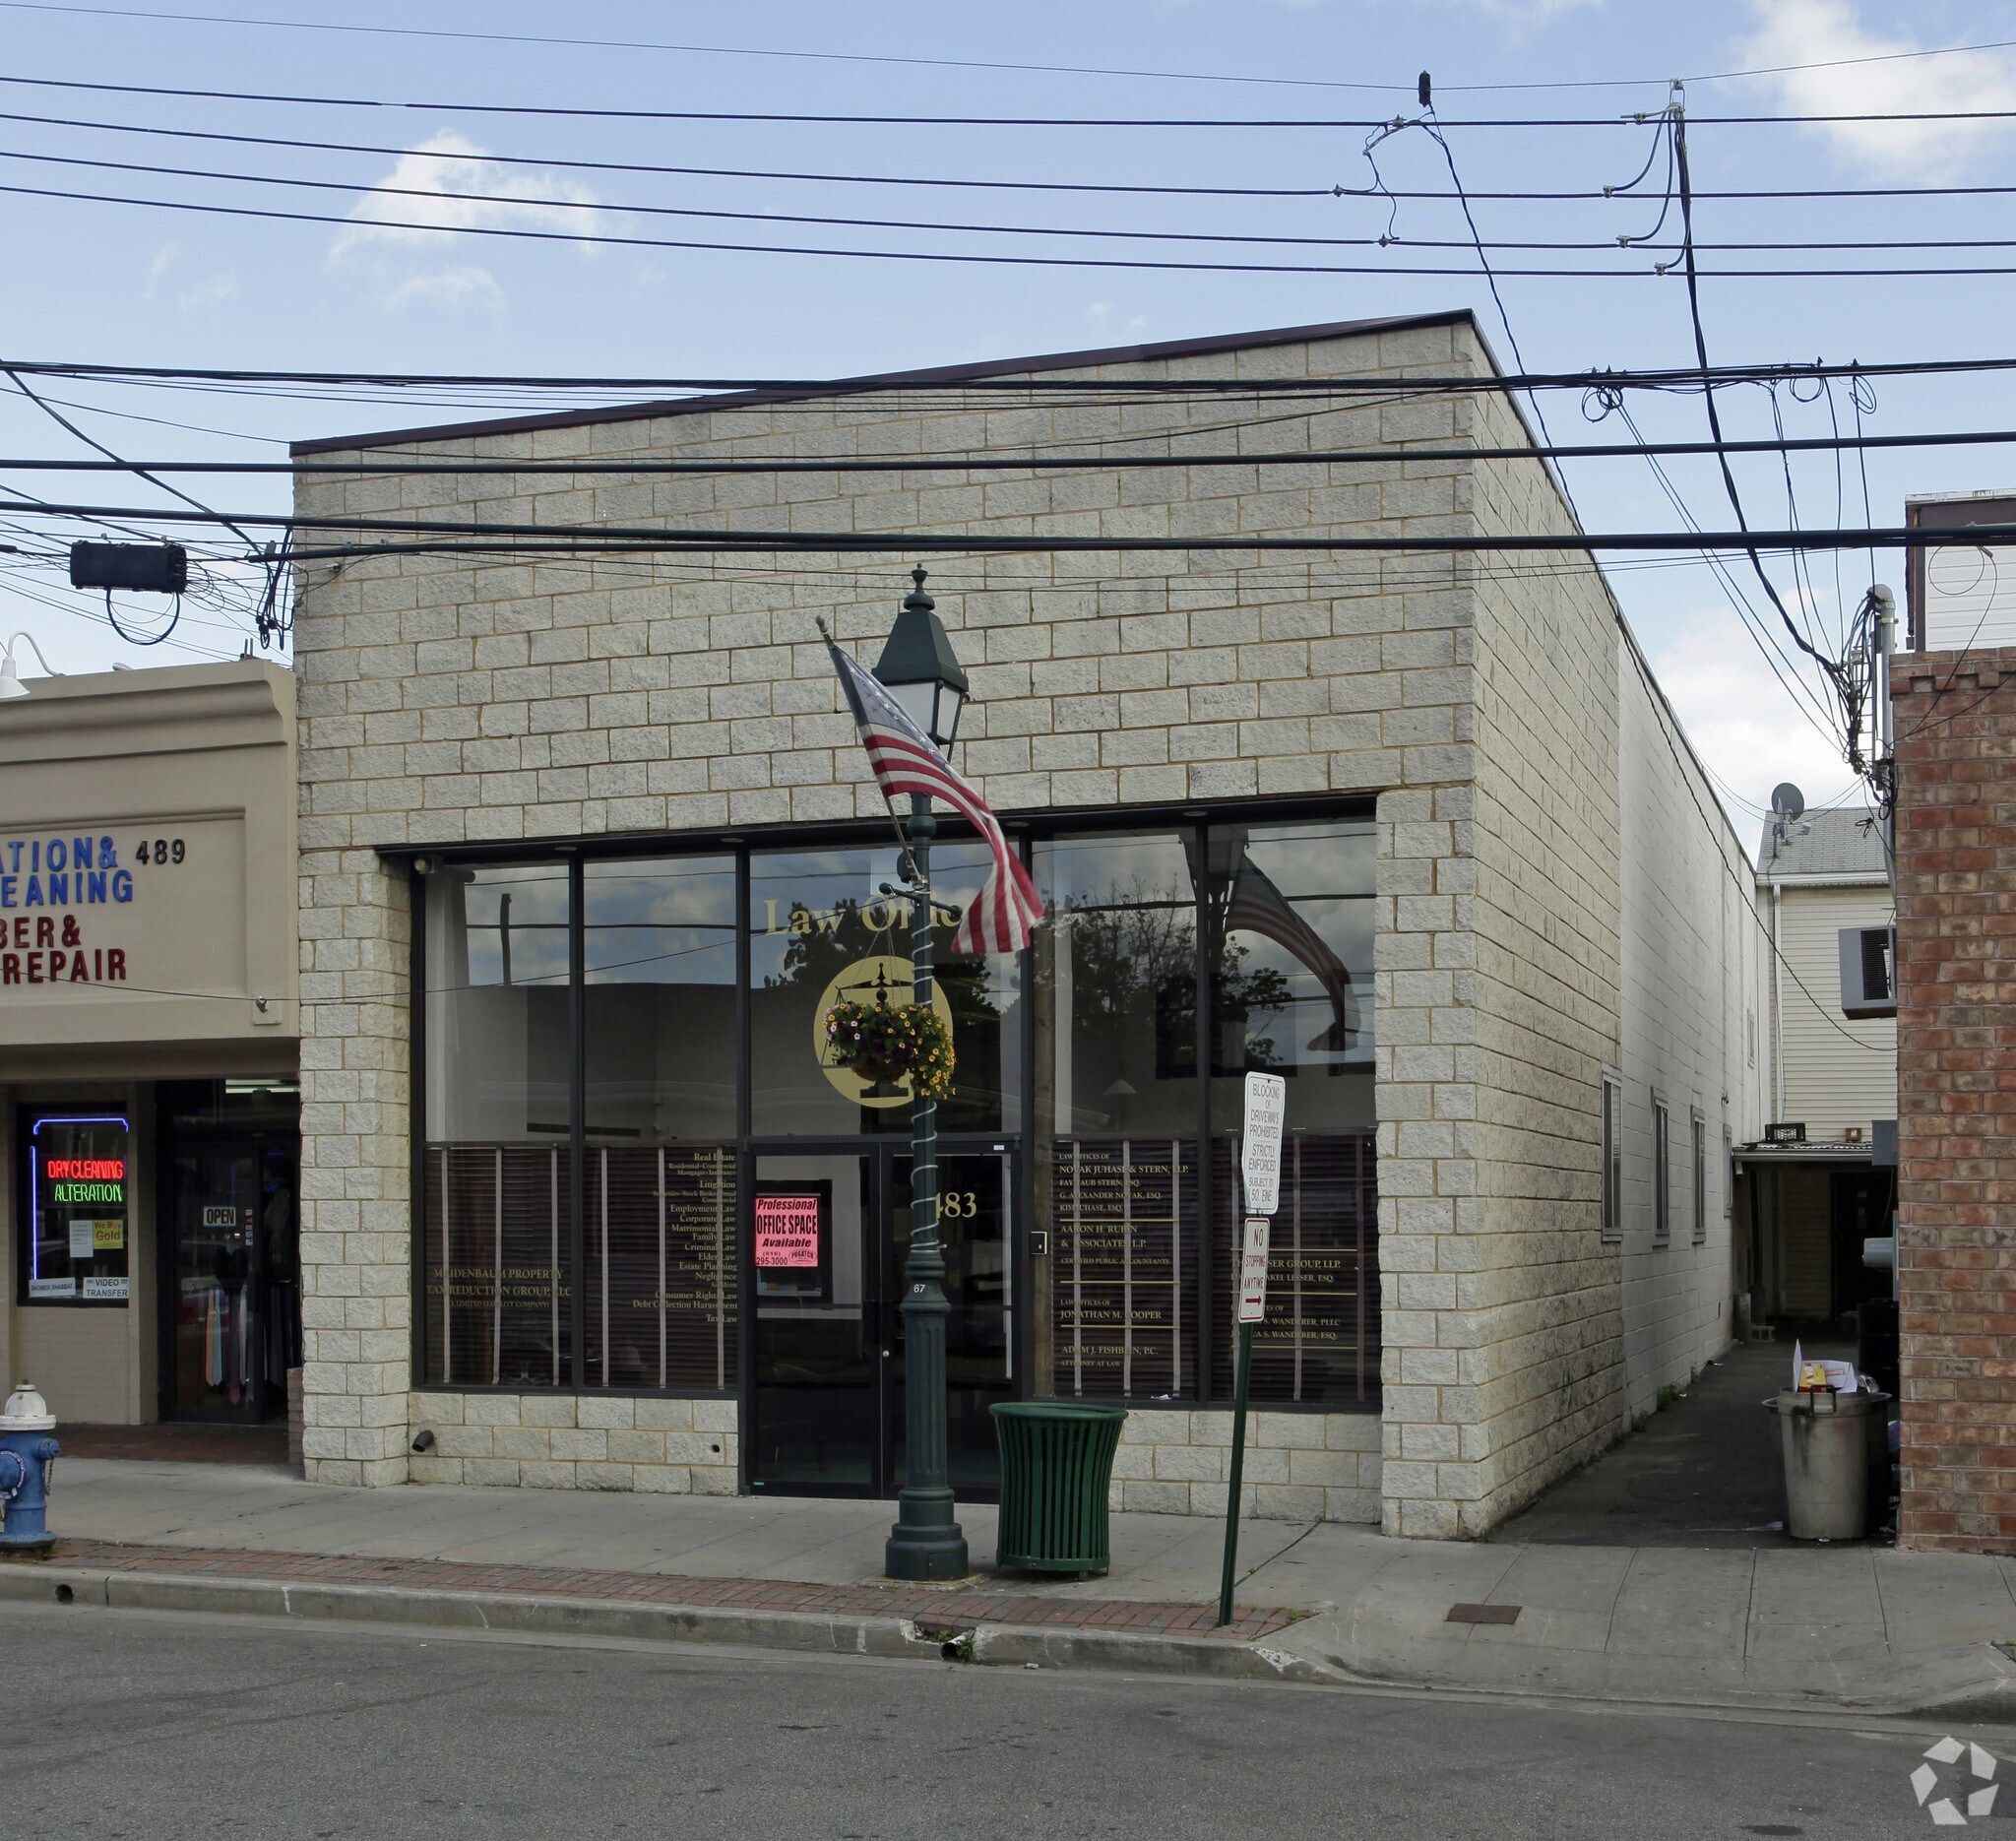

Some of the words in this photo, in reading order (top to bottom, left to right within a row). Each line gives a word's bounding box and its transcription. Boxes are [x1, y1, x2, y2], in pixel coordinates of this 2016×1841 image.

[0, 835, 117, 874] TION&
[136, 838, 185, 864] 489
[764, 899, 846, 934] Law
[3, 948, 126, 984] REPAIR
[1252, 1083, 1280, 1100] BLOCKING
[1265, 1100, 1271, 1109] OF
[1250, 1109, 1279, 1124] DRIVEWAYS
[1249, 1124, 1279, 1139] PROHIBITED
[1252, 1144, 1275, 1158] STRICTLY
[47, 1160, 69, 1178] DRY
[71, 1160, 123, 1178] CLEANING
[1248, 1158, 1276, 1172] ENFORCED
[700, 1180, 736, 1189] Litigation
[1248, 1176, 1268, 1187] SUBJECT
[54, 1183, 122, 1202] ALTERATION
[670, 1204, 718, 1214] Employment
[757, 1199, 816, 1210] Professional
[207, 1208, 235, 1225] OPEN
[679, 1214, 718, 1224] Corporate
[106, 1221, 121, 1230] Buy
[757, 1214, 787, 1235] OFFICE
[788, 1214, 816, 1235] SPACE
[95, 1231, 120, 1240] Gold
[692, 1233, 718, 1241] Family
[1253, 1228, 1263, 1246] NO
[762, 1238, 811, 1247] Available
[678, 1261, 701, 1270] Estate
[704, 1262, 737, 1272] Planning
[1244, 1255, 1266, 1267] STOPPING
[1287, 1259, 1321, 1269] GROUP,
[509, 1269, 563, 1279] PROPERTY
[695, 1272, 737, 1281] Negligence
[914, 1284, 925, 1293] 67
[1244, 1277, 1263, 1289] ANYTIME
[449, 1285, 511, 1296] REDUCTION
[513, 1286, 550, 1298] GROUP,
[1060, 1310, 1109, 1319] JONATHAN
